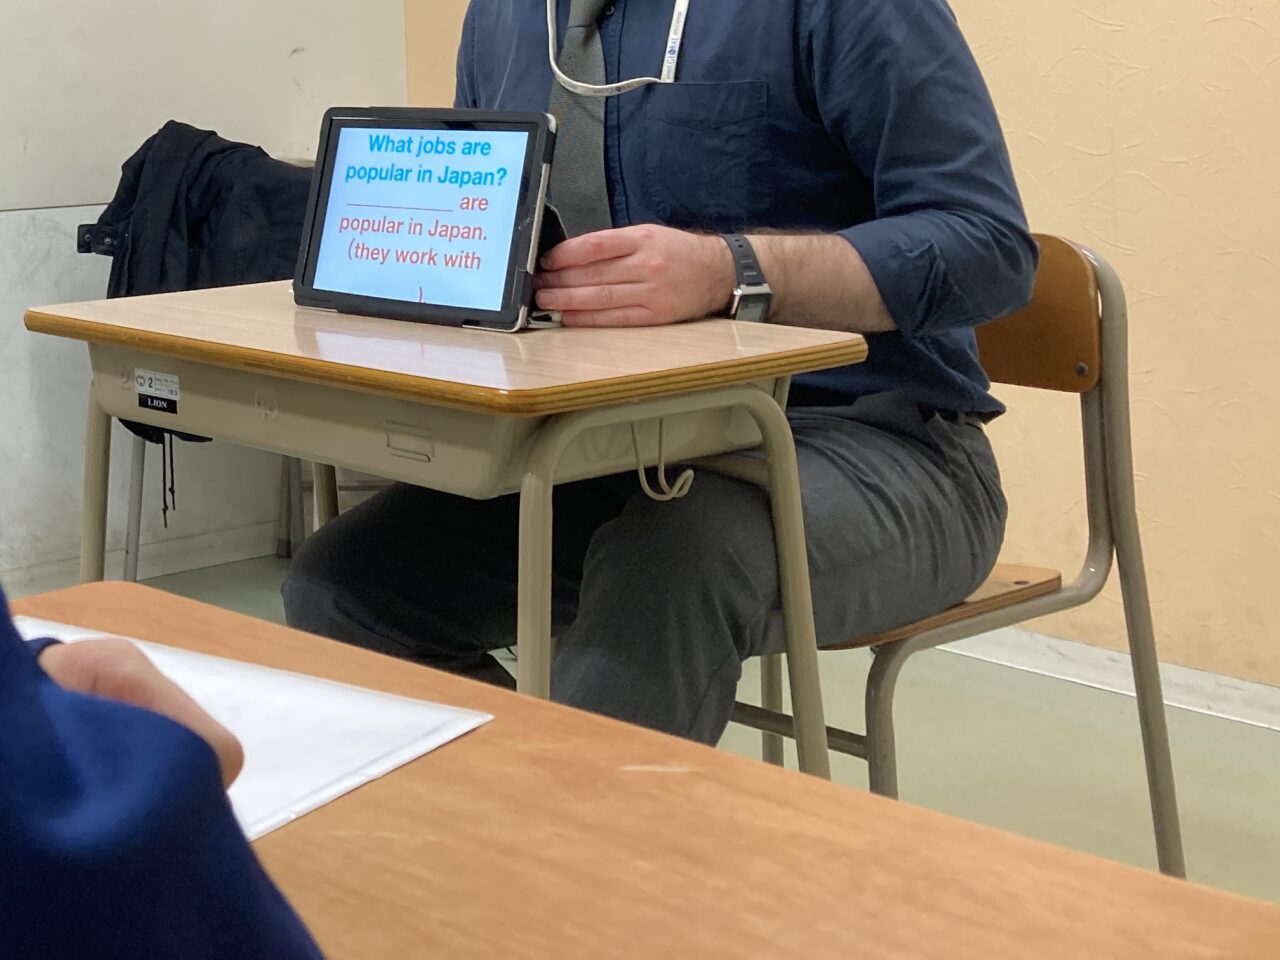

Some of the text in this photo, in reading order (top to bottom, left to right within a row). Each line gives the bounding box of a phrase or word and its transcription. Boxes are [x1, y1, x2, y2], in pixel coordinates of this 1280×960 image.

[369, 134, 491, 158] What jobs are
[345, 164, 507, 188] popular in Japan?
[460, 196, 489, 211] are
[339, 216, 487, 241] popular in Japan.
[348, 238, 481, 270] (they work with
[149, 377, 153, 388] 2
[148, 398, 167, 408] LION
